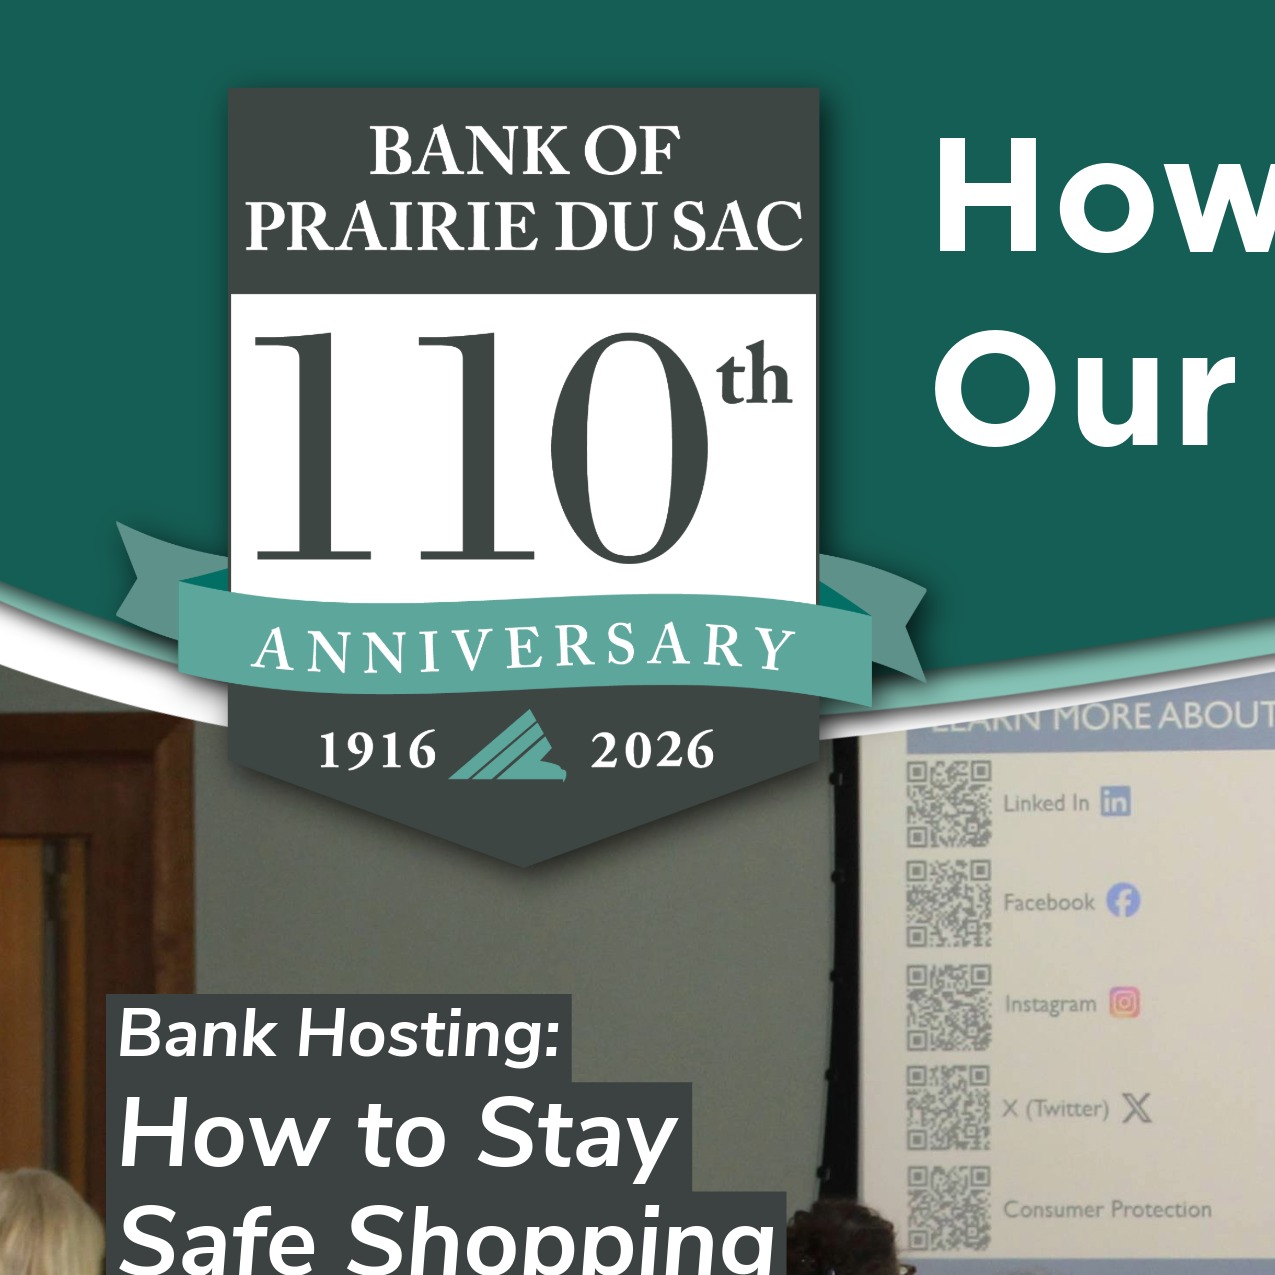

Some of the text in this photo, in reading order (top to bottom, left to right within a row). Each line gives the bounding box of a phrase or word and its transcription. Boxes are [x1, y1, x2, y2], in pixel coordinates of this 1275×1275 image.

[1052, 701, 1153, 731] MORE
[1003, 793, 1090, 813] Linked In
[1003, 892, 1096, 912] Facebook
[1005, 994, 1097, 1018] Instagram
[1002, 1098, 1110, 1122] X (Twitter)
[1003, 1199, 1212, 1219] Consumer Protection
